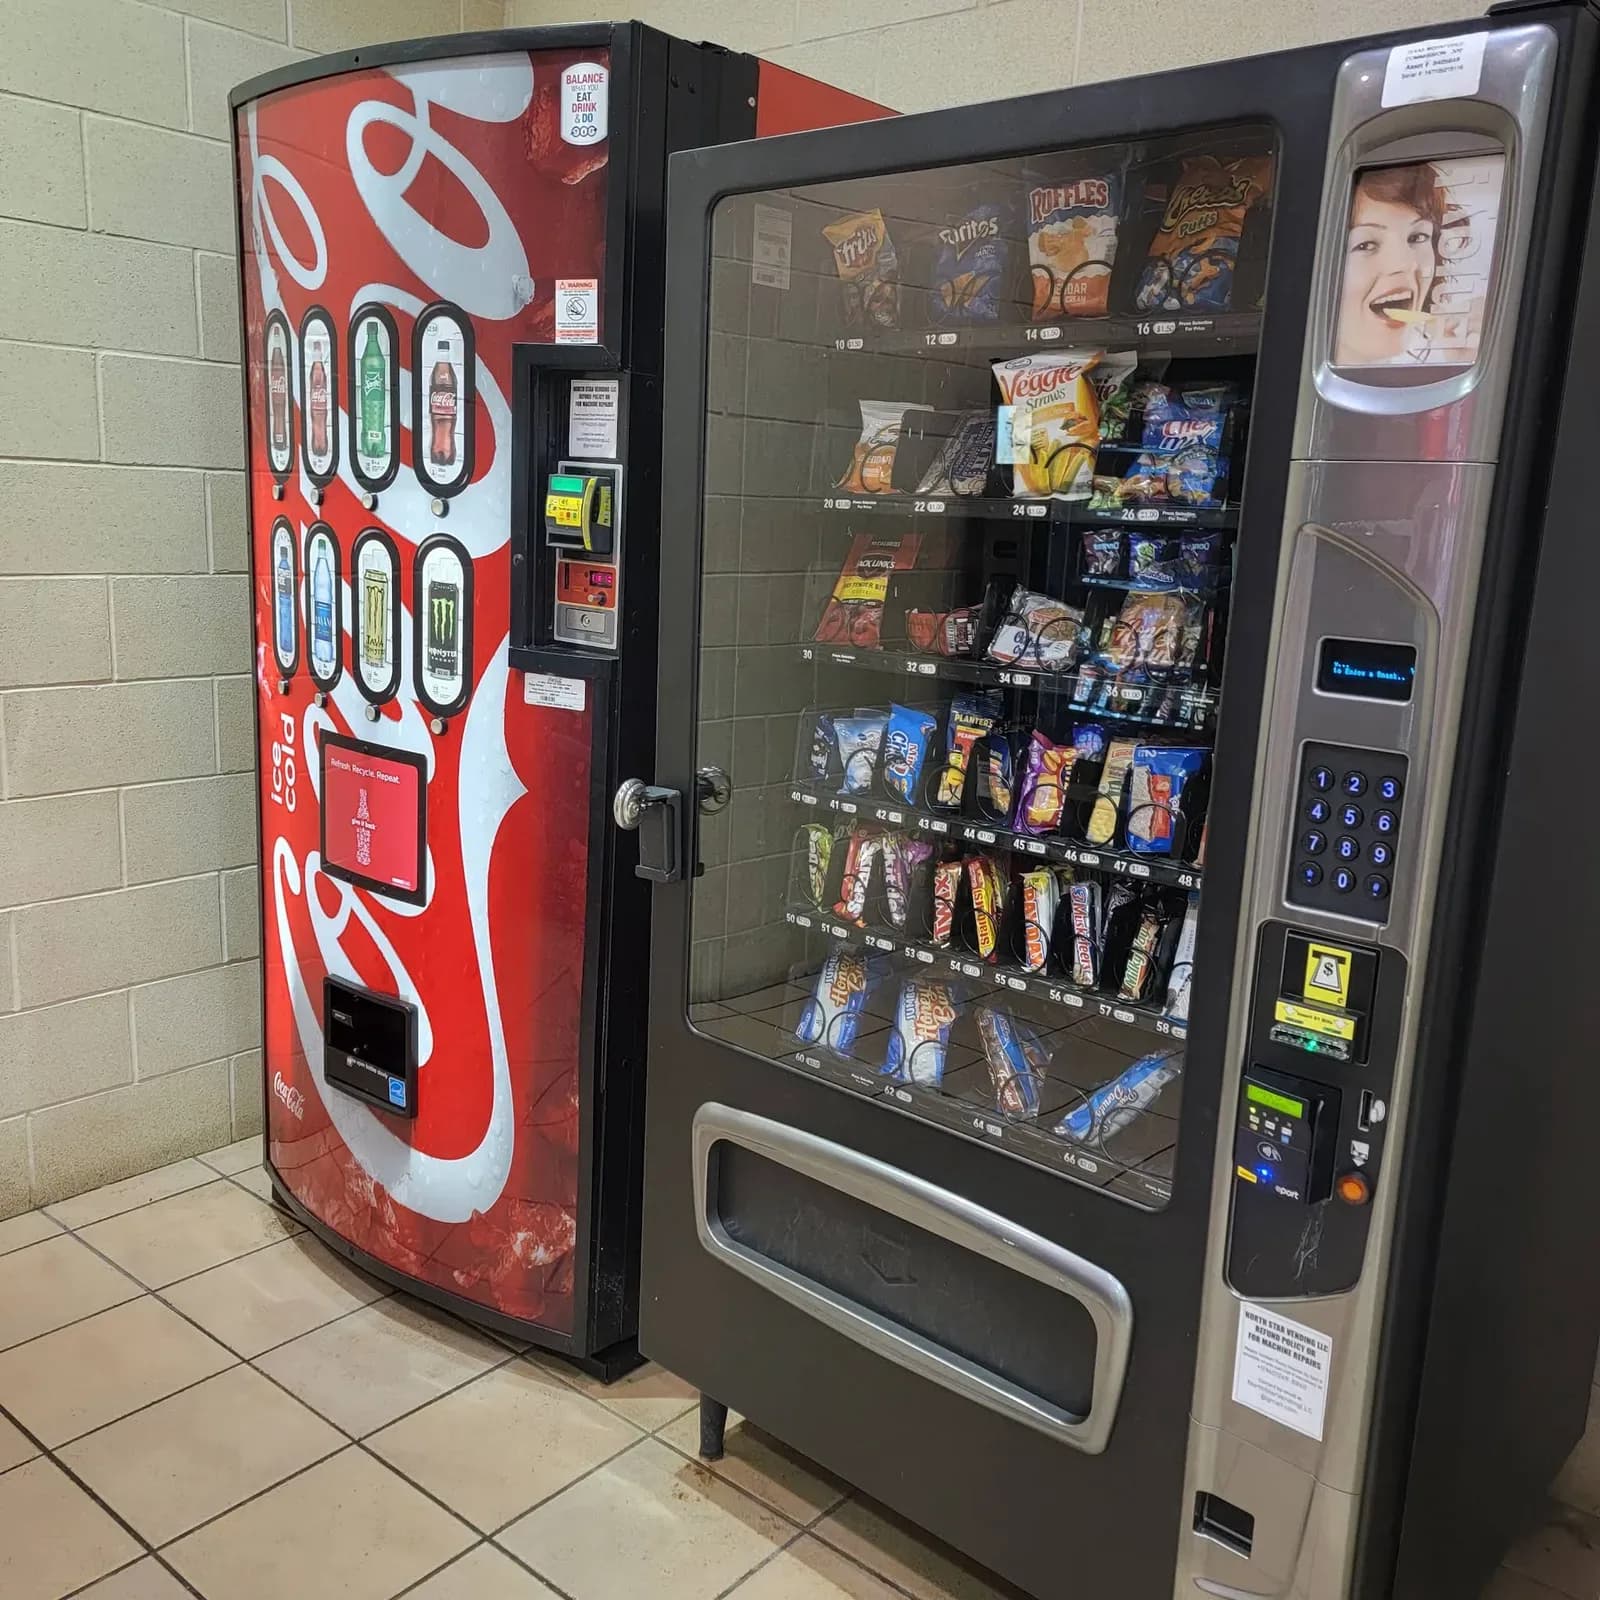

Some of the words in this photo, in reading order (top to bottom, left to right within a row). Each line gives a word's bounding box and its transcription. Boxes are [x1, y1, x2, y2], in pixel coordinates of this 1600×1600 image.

[566, 73, 604, 84] BALANCE
[572, 102, 597, 112] DRINK
[575, 114, 580, 123] &
[582, 113, 593, 122] DO
[1030, 179, 1109, 224] RUFFLES
[1025, 329, 1037, 340] 14
[1137, 323, 1150, 335] 16
[834, 339, 845, 350] 10
[925, 334, 936, 345] 12
[1000, 365, 1081, 405] Veggie
[1025, 388, 1067, 413] Straws
[824, 499, 833, 508] 20
[914, 502, 925, 512] 22
[1013, 505, 1024, 515] 24
[1122, 509, 1135, 520] 26
[802, 650, 812, 659] 30
[906, 662, 917, 672] 32
[999, 674, 1010, 684] 34
[1106, 687, 1118, 697] 36
[954, 712, 993, 729] PLANTERS
[281, 713, 296, 813] cold
[271, 741, 282, 805] ice
[1317, 771, 1326, 788] 1
[1349, 776, 1360, 792] 2
[1382, 782, 1394, 798] 3
[791, 791, 800, 801] 40
[829, 800, 839, 810] 41
[876, 810, 886, 820] 42
[1311, 803, 1322, 819] 4
[1344, 809, 1356, 825] 5
[919, 818, 929, 829] 43
[1378, 815, 1390, 831] 6
[964, 828, 975, 839] 44
[1013, 839, 1025, 850] 45
[1309, 835, 1319, 850] 7
[1341, 841, 1351, 857] 8
[1065, 850, 1077, 861] 46
[1374, 847, 1385, 863] 9
[1114, 861, 1126, 872] 47
[1178, 874, 1192, 887] 48
[1337, 872, 1347, 888] 0
[934, 874, 953, 942] TWIX
[786, 913, 795, 922] 50
[821, 923, 830, 933] 51
[865, 936, 875, 945] 52
[904, 947, 915, 957] 53
[950, 961, 961, 971] 54
[1123, 953, 1145, 987] Milky
[829, 954, 852, 1008] Honey
[995, 974, 1006, 985] 55
[1049, 990, 1061, 1001] 56
[914, 983, 933, 1042] Honey
[1100, 1005, 1111, 1016] 57
[1156, 1022, 1170, 1033] 58
[795, 1052, 805, 1063] 60
[884, 1085, 894, 1096] 62
[973, 1118, 984, 1130] 64
[1063, 1152, 1076, 1164] 66
[1274, 1185, 1300, 1200] eport
[1245, 1311, 1267, 1326] NORTH
[1268, 1319, 1285, 1333] STAR
[1286, 1327, 1316, 1348] VENDING
[1317, 1341, 1328, 1353] LLC
[1255, 1325, 1280, 1342] REFUND
[1281, 1336, 1305, 1353] POLICY
[1248, 1332, 1260, 1343] FOR
[1261, 1337, 1292, 1357] MACHINE
[1293, 1351, 1321, 1370] REPAIRS
